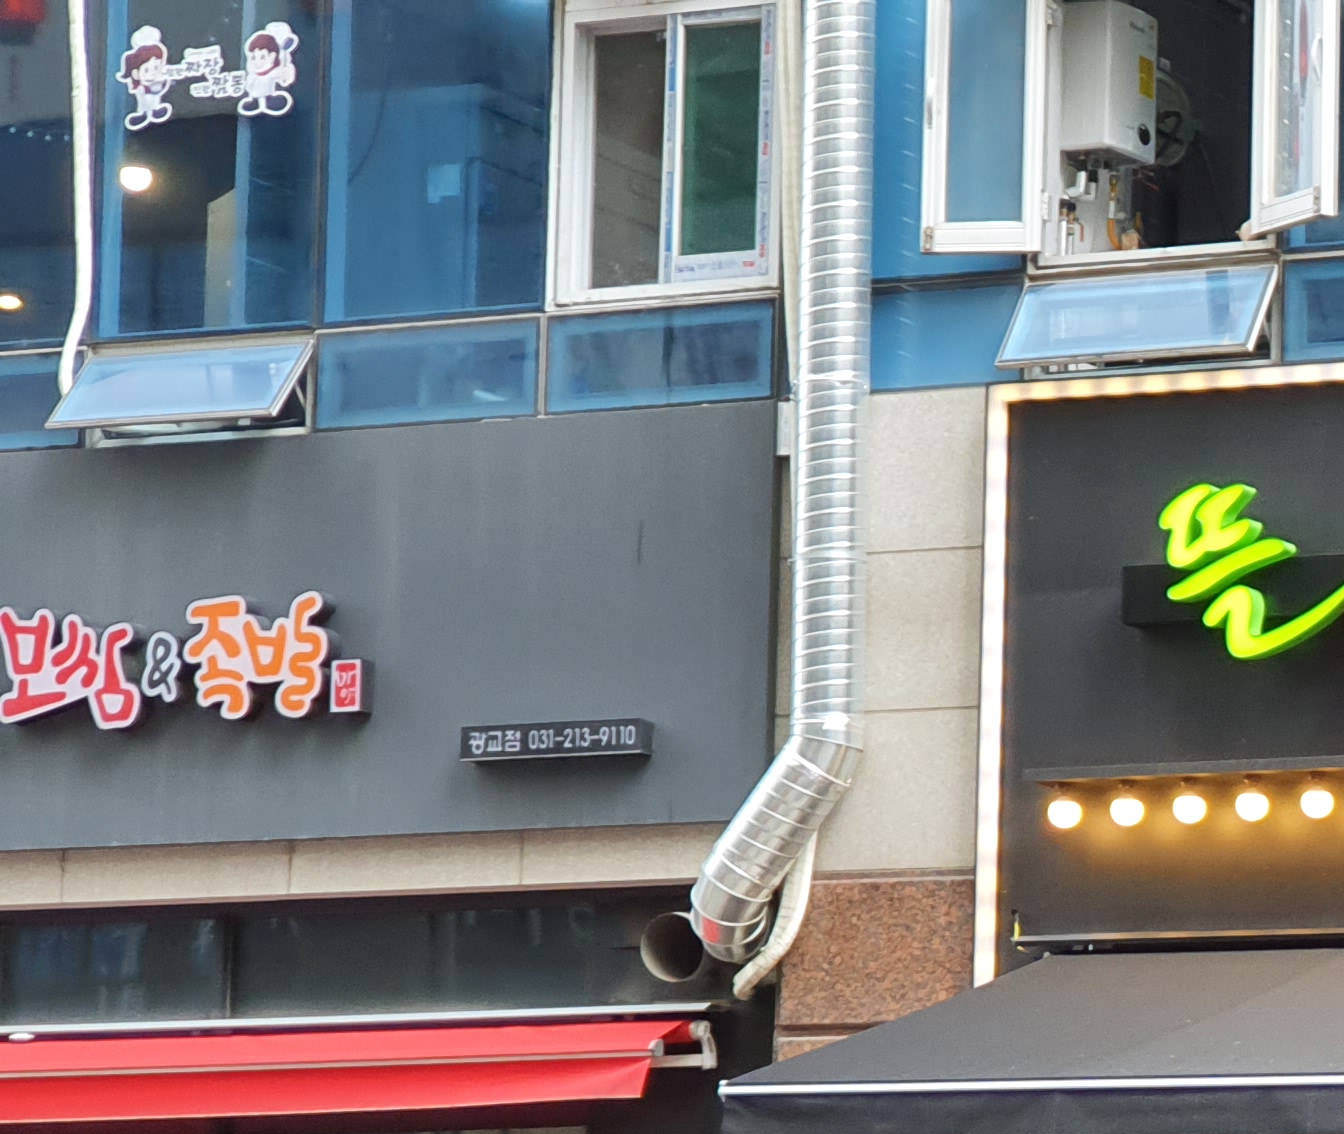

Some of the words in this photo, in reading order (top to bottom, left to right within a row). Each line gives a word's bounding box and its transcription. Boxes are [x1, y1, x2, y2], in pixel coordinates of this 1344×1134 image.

[186, 593, 325, 714] 족발
[468, 729, 522, 756] 광교점
[528, 725, 637, 750] 031-213-9110
